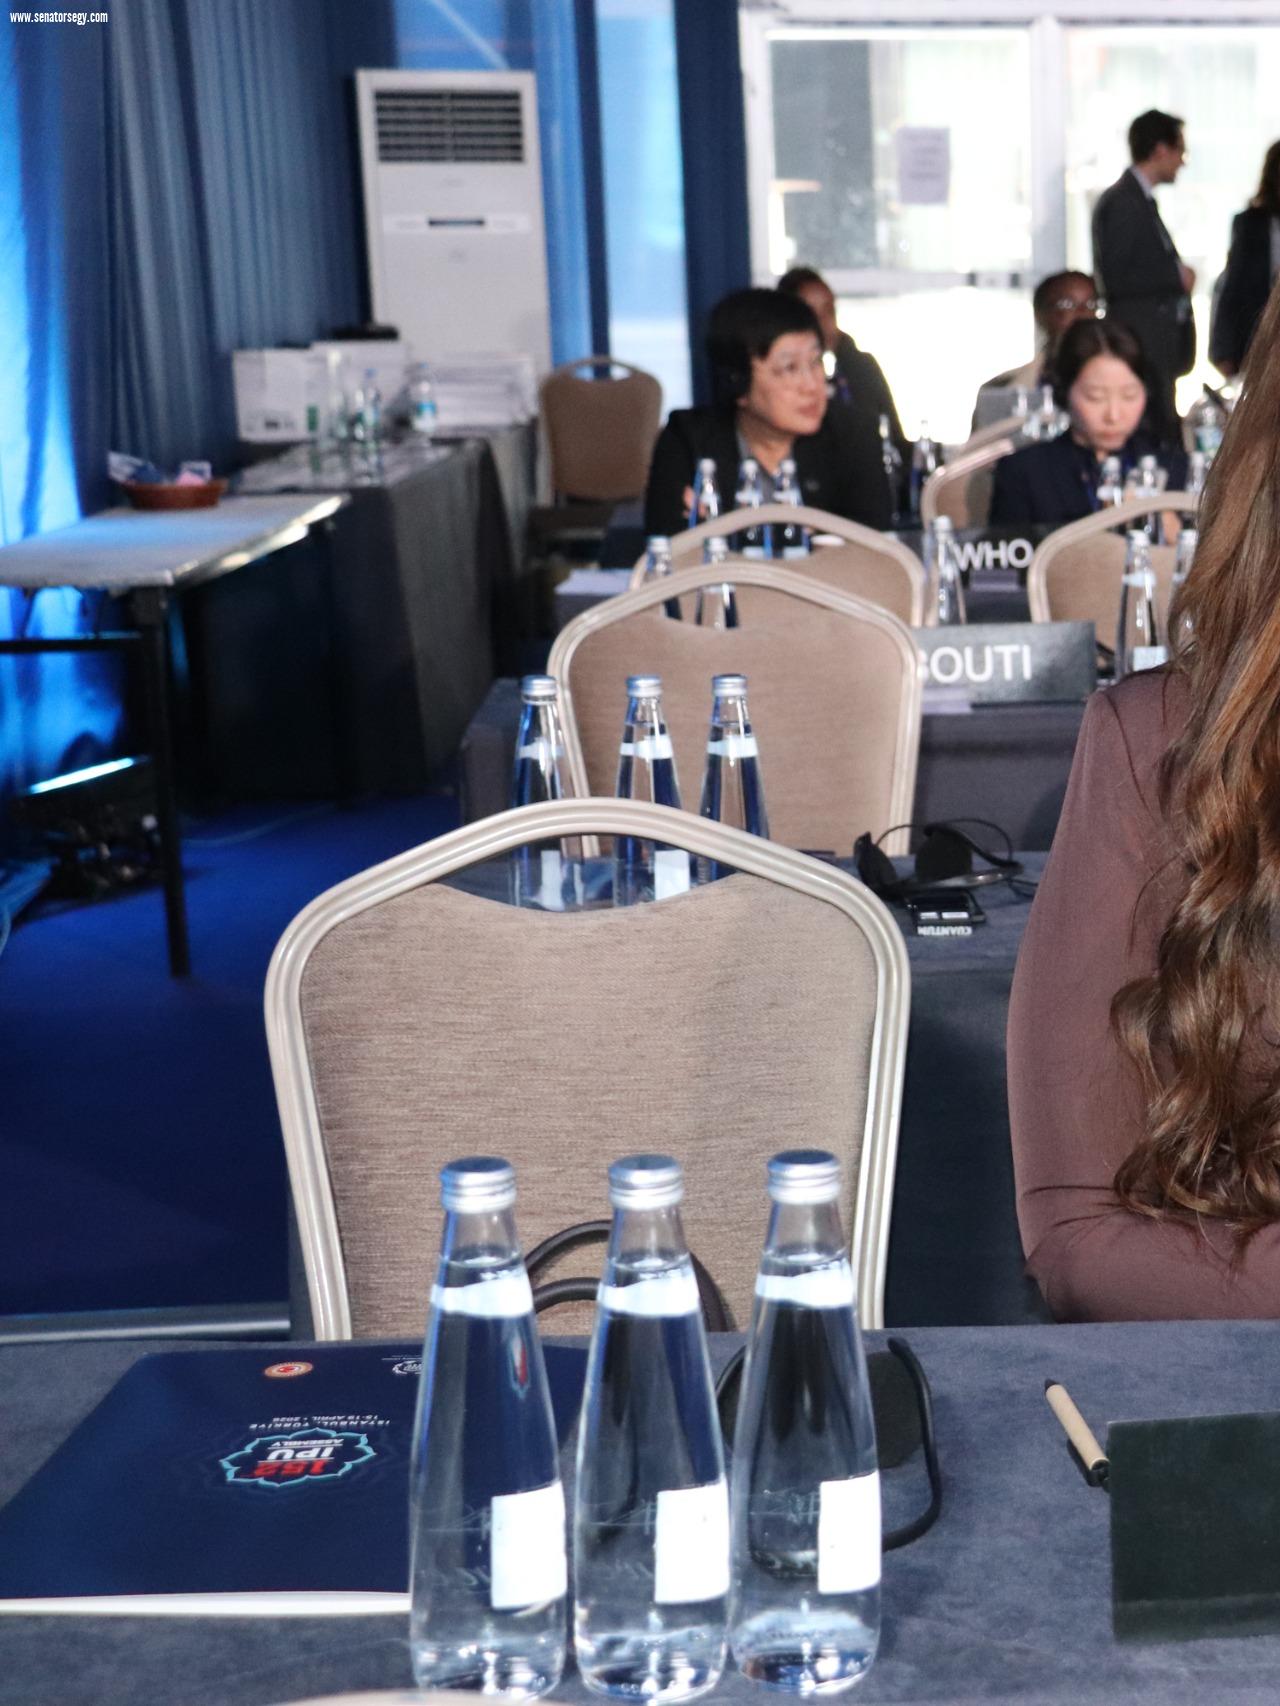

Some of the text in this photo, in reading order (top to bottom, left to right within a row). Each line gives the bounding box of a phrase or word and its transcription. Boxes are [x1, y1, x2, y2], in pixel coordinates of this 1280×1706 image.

[954, 538, 1034, 571] WHO
[270, 1438, 345, 1448] ASSEMBLY
[266, 1447, 335, 1461] IPU
